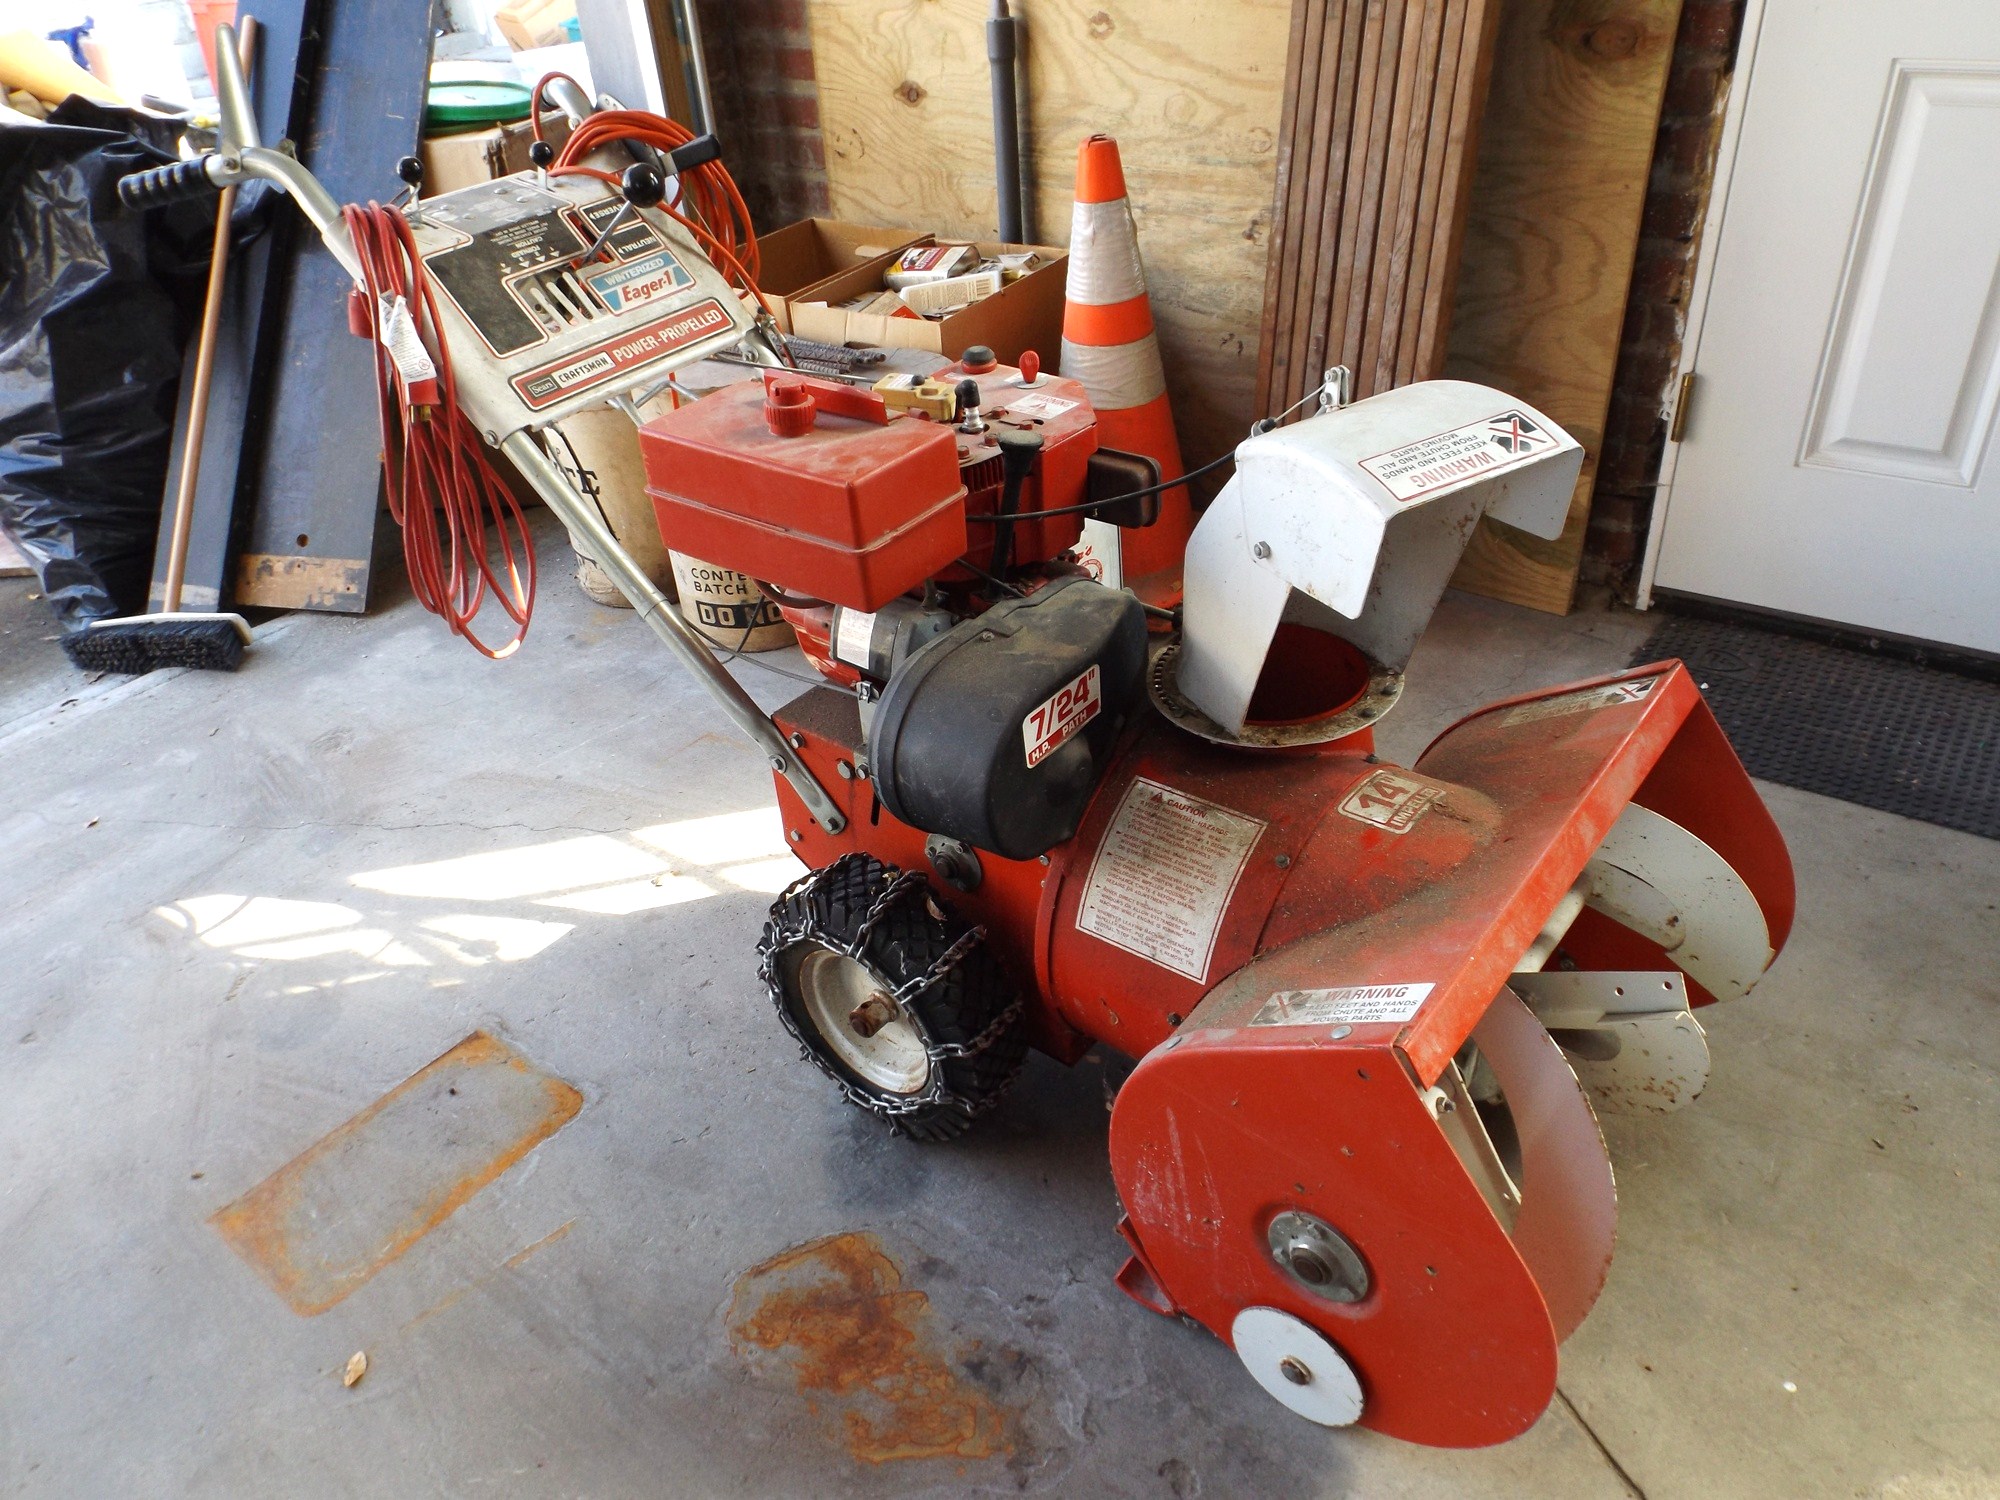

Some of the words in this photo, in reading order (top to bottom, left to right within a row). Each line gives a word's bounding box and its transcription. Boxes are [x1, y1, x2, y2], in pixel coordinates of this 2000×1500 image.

[594, 204, 625, 220] EVERSE
[514, 236, 543, 249] CAUTION
[622, 236, 658, 252] NEUTRAL
[604, 258, 664, 286] WINTERIZED
[622, 270, 672, 302] Eager-1
[533, 383, 553, 394] Sears
[558, 357, 608, 383] CRAFTSMAN
[612, 309, 722, 362] POWER-PROPELLED
[1421, 432, 1459, 448] MOVING
[1450, 434, 1478, 446] FROM
[1462, 440, 1487, 452] KEEP
[1390, 445, 1420, 458] PARTS
[1417, 443, 1450, 458] CHUTE
[1438, 448, 1462, 461] FEET
[1378, 461, 1394, 471] ALL
[1397, 453, 1416, 465] AND
[1416, 456, 1435, 467] AND
[1381, 464, 1415, 479] HANDS
[1408, 450, 1496, 488] WARNING
[691, 568, 752, 581] CONTE
[694, 581, 747, 595] BATCH
[700, 604, 735, 626] DO
[1030, 668, 1095, 742] 7/24"
[1031, 742, 1051, 762] H.P.
[1062, 710, 1087, 737] PATH
[1358, 776, 1410, 809] 14"
[1166, 799, 1207, 818] CAUTION
[1196, 820, 1229, 836] HAZARDS
[1325, 986, 1408, 1001] WARNING
